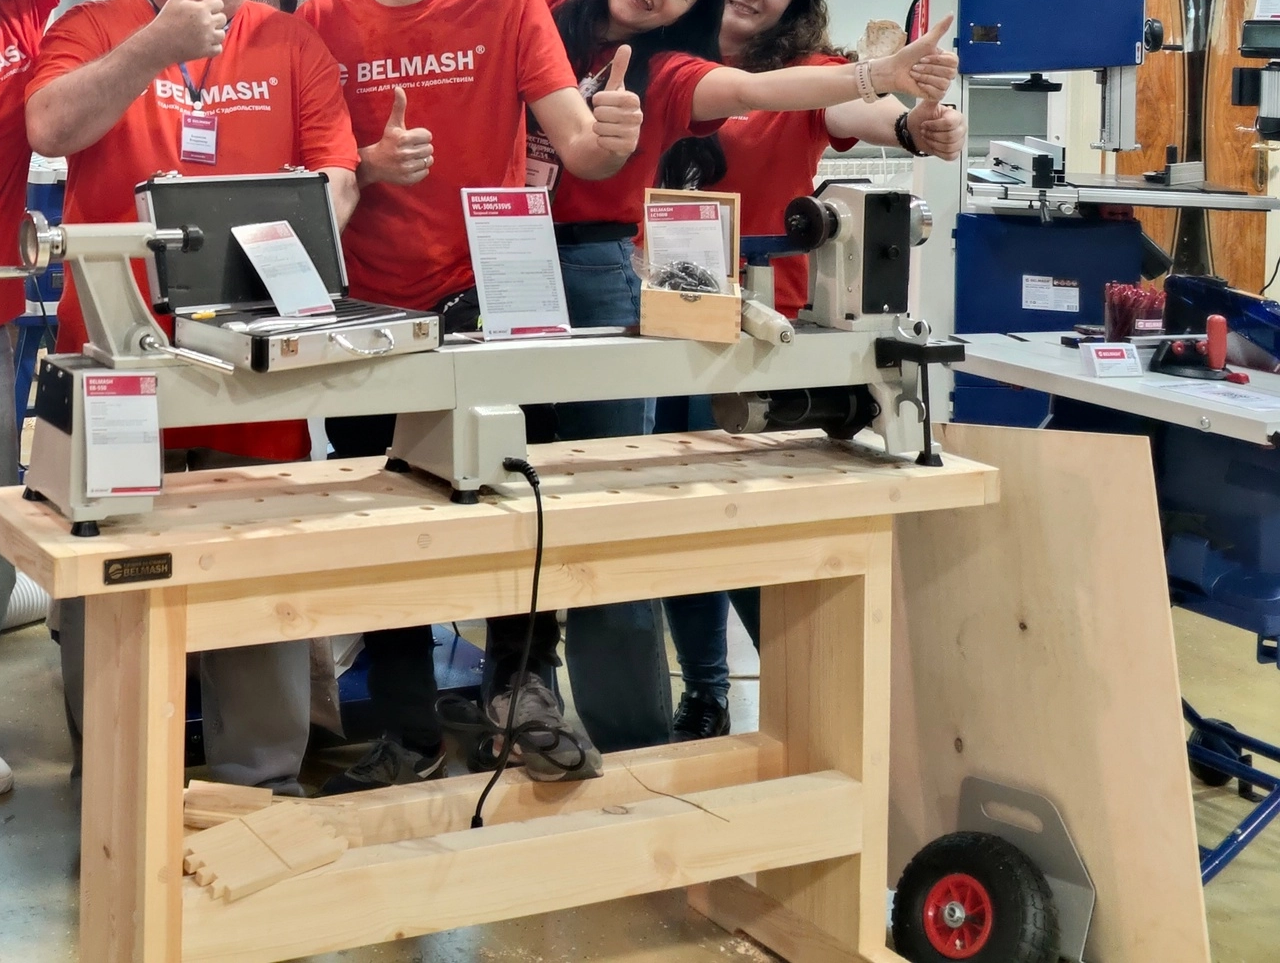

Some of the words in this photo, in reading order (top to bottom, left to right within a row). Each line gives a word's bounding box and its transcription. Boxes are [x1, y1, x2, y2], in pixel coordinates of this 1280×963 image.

[356, 86, 377, 94] СТАНКИ
[421, 76, 474, 87] УДОВОЛЬСТВИЕМ
[221, 105, 271, 114] УДОВОЛЬСТВИЕМ
[123, 564, 168, 577] BELMASH
